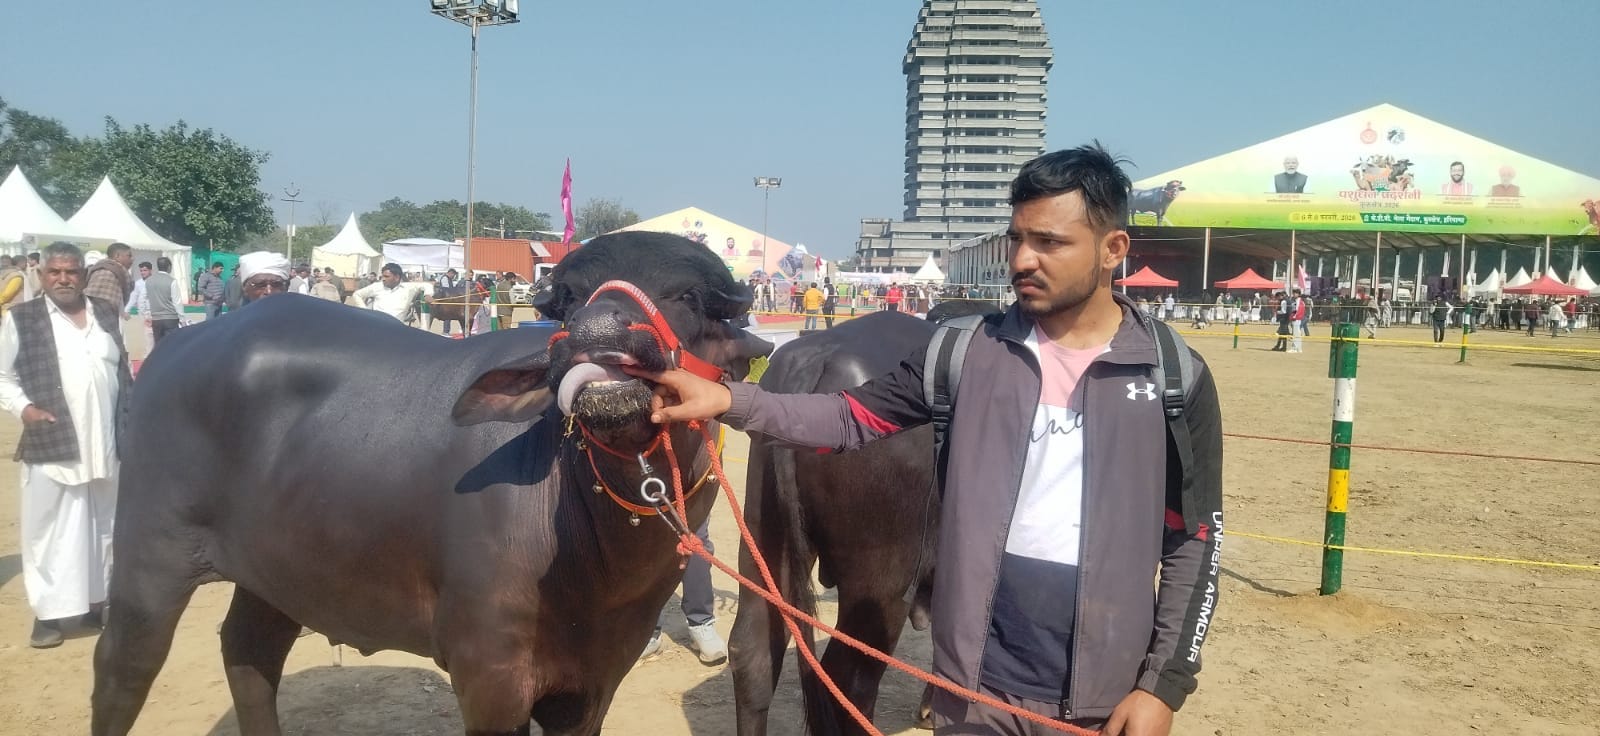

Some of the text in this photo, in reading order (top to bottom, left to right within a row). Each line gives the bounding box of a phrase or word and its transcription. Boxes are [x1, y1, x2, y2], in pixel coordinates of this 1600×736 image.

[1339, 189, 1421, 202] पशुधन प्रदर्शनी
[1187, 581, 1216, 663] ARMOUR
